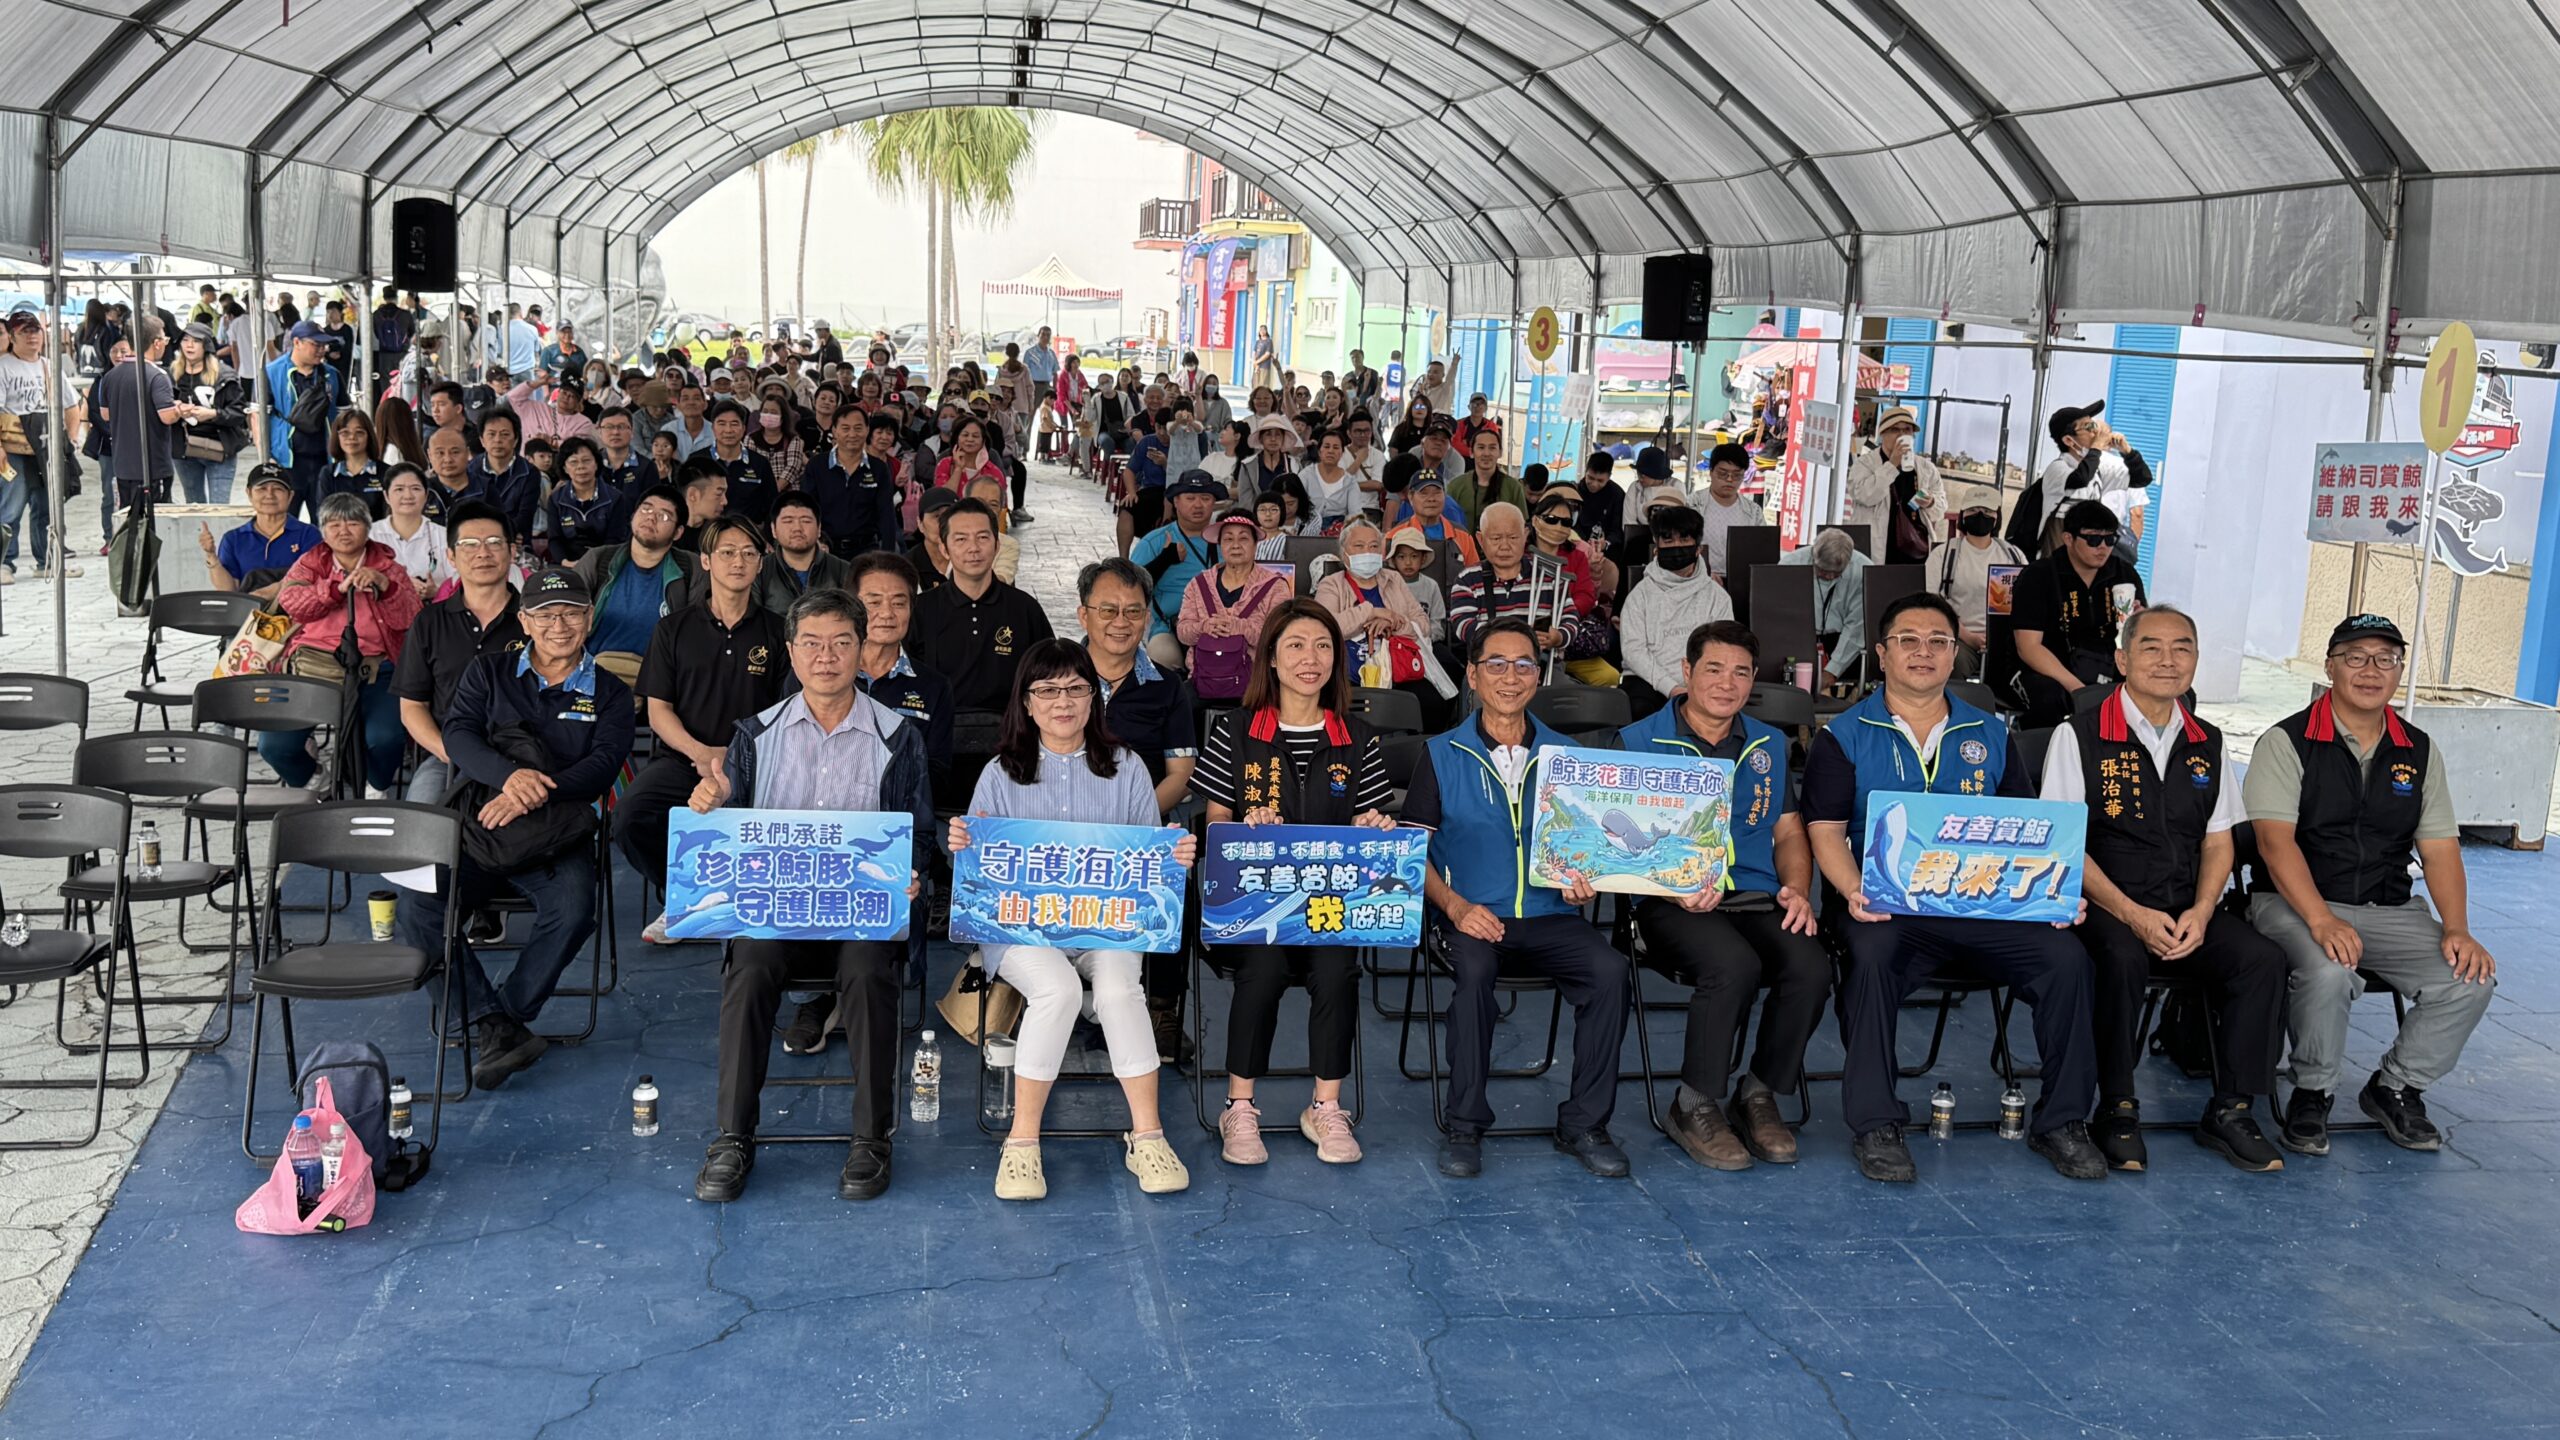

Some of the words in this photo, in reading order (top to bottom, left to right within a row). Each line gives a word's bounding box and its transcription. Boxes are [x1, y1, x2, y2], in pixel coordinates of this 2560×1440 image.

[1535, 317, 1550, 352] 3
[1389, 369, 1402, 383] 9
[2436, 347, 2458, 428] 1
[2318, 464, 2423, 489] 維納司賞鯨
[2316, 495, 2420, 520] 請跟我來
[1549, 754, 1640, 790] 鯨彩花蓮
[1642, 766, 1724, 797] 守護有你
[2100, 759, 2124, 819] 張治華
[1584, 790, 1633, 806] 海洋保育
[1636, 794, 1685, 809] 由我做起
[740, 821, 843, 846] 我們承諾
[1936, 813, 2052, 846] 友善賞鯨
[695, 851, 854, 888] 珍愛鯨豚
[980, 840, 1163, 892] 守護海洋
[1907, 850, 2067, 899] 我來了!
[735, 888, 892, 927] 守護黑潮
[998, 892, 1137, 931] 由我做起
[1306, 896, 1405, 933] 我做起
